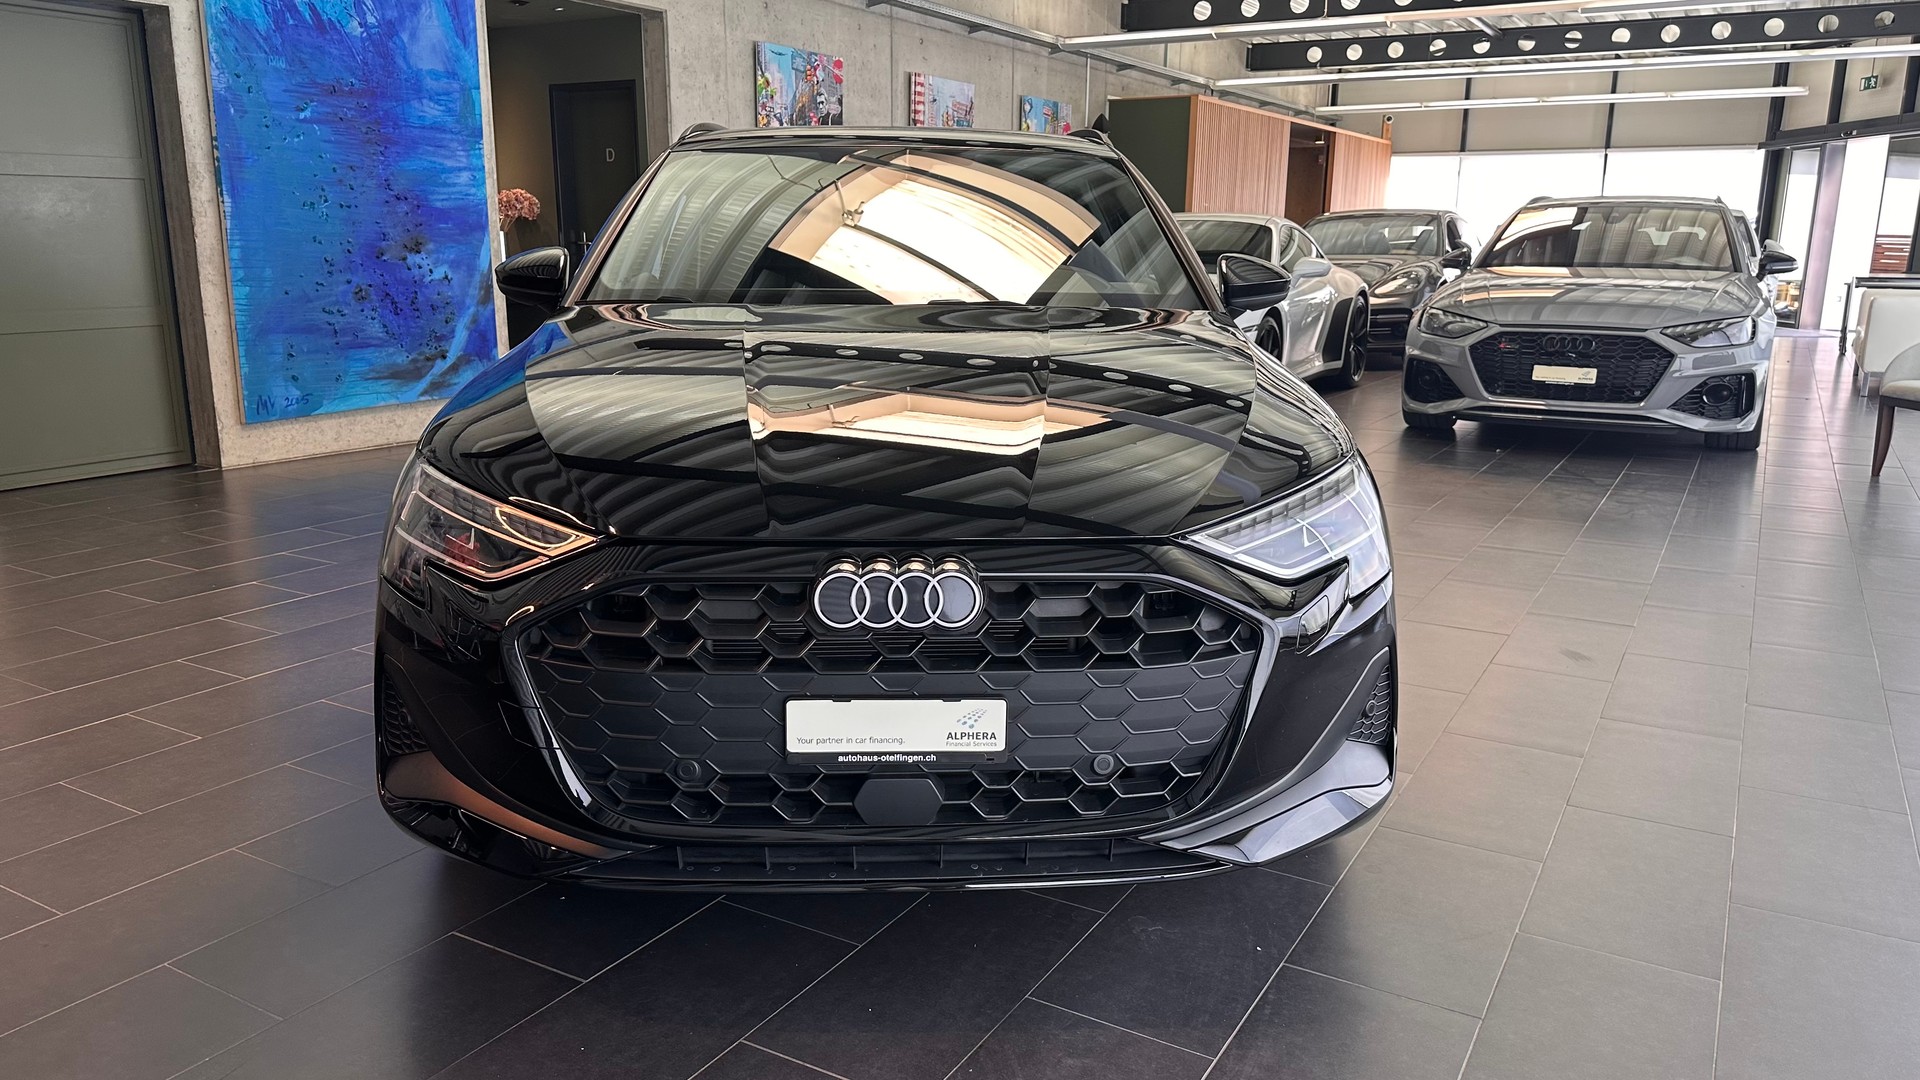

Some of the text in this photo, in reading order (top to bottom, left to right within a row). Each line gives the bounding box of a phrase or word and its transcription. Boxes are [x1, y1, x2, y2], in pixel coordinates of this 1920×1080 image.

[606, 148, 615, 162] D
[946, 732, 997, 740] ALPHERA
[816, 736, 844, 745] partner
[846, 736, 853, 744] in
[869, 736, 906, 746] financing.
[838, 754, 937, 763] autohaus-otelfingen.ch
